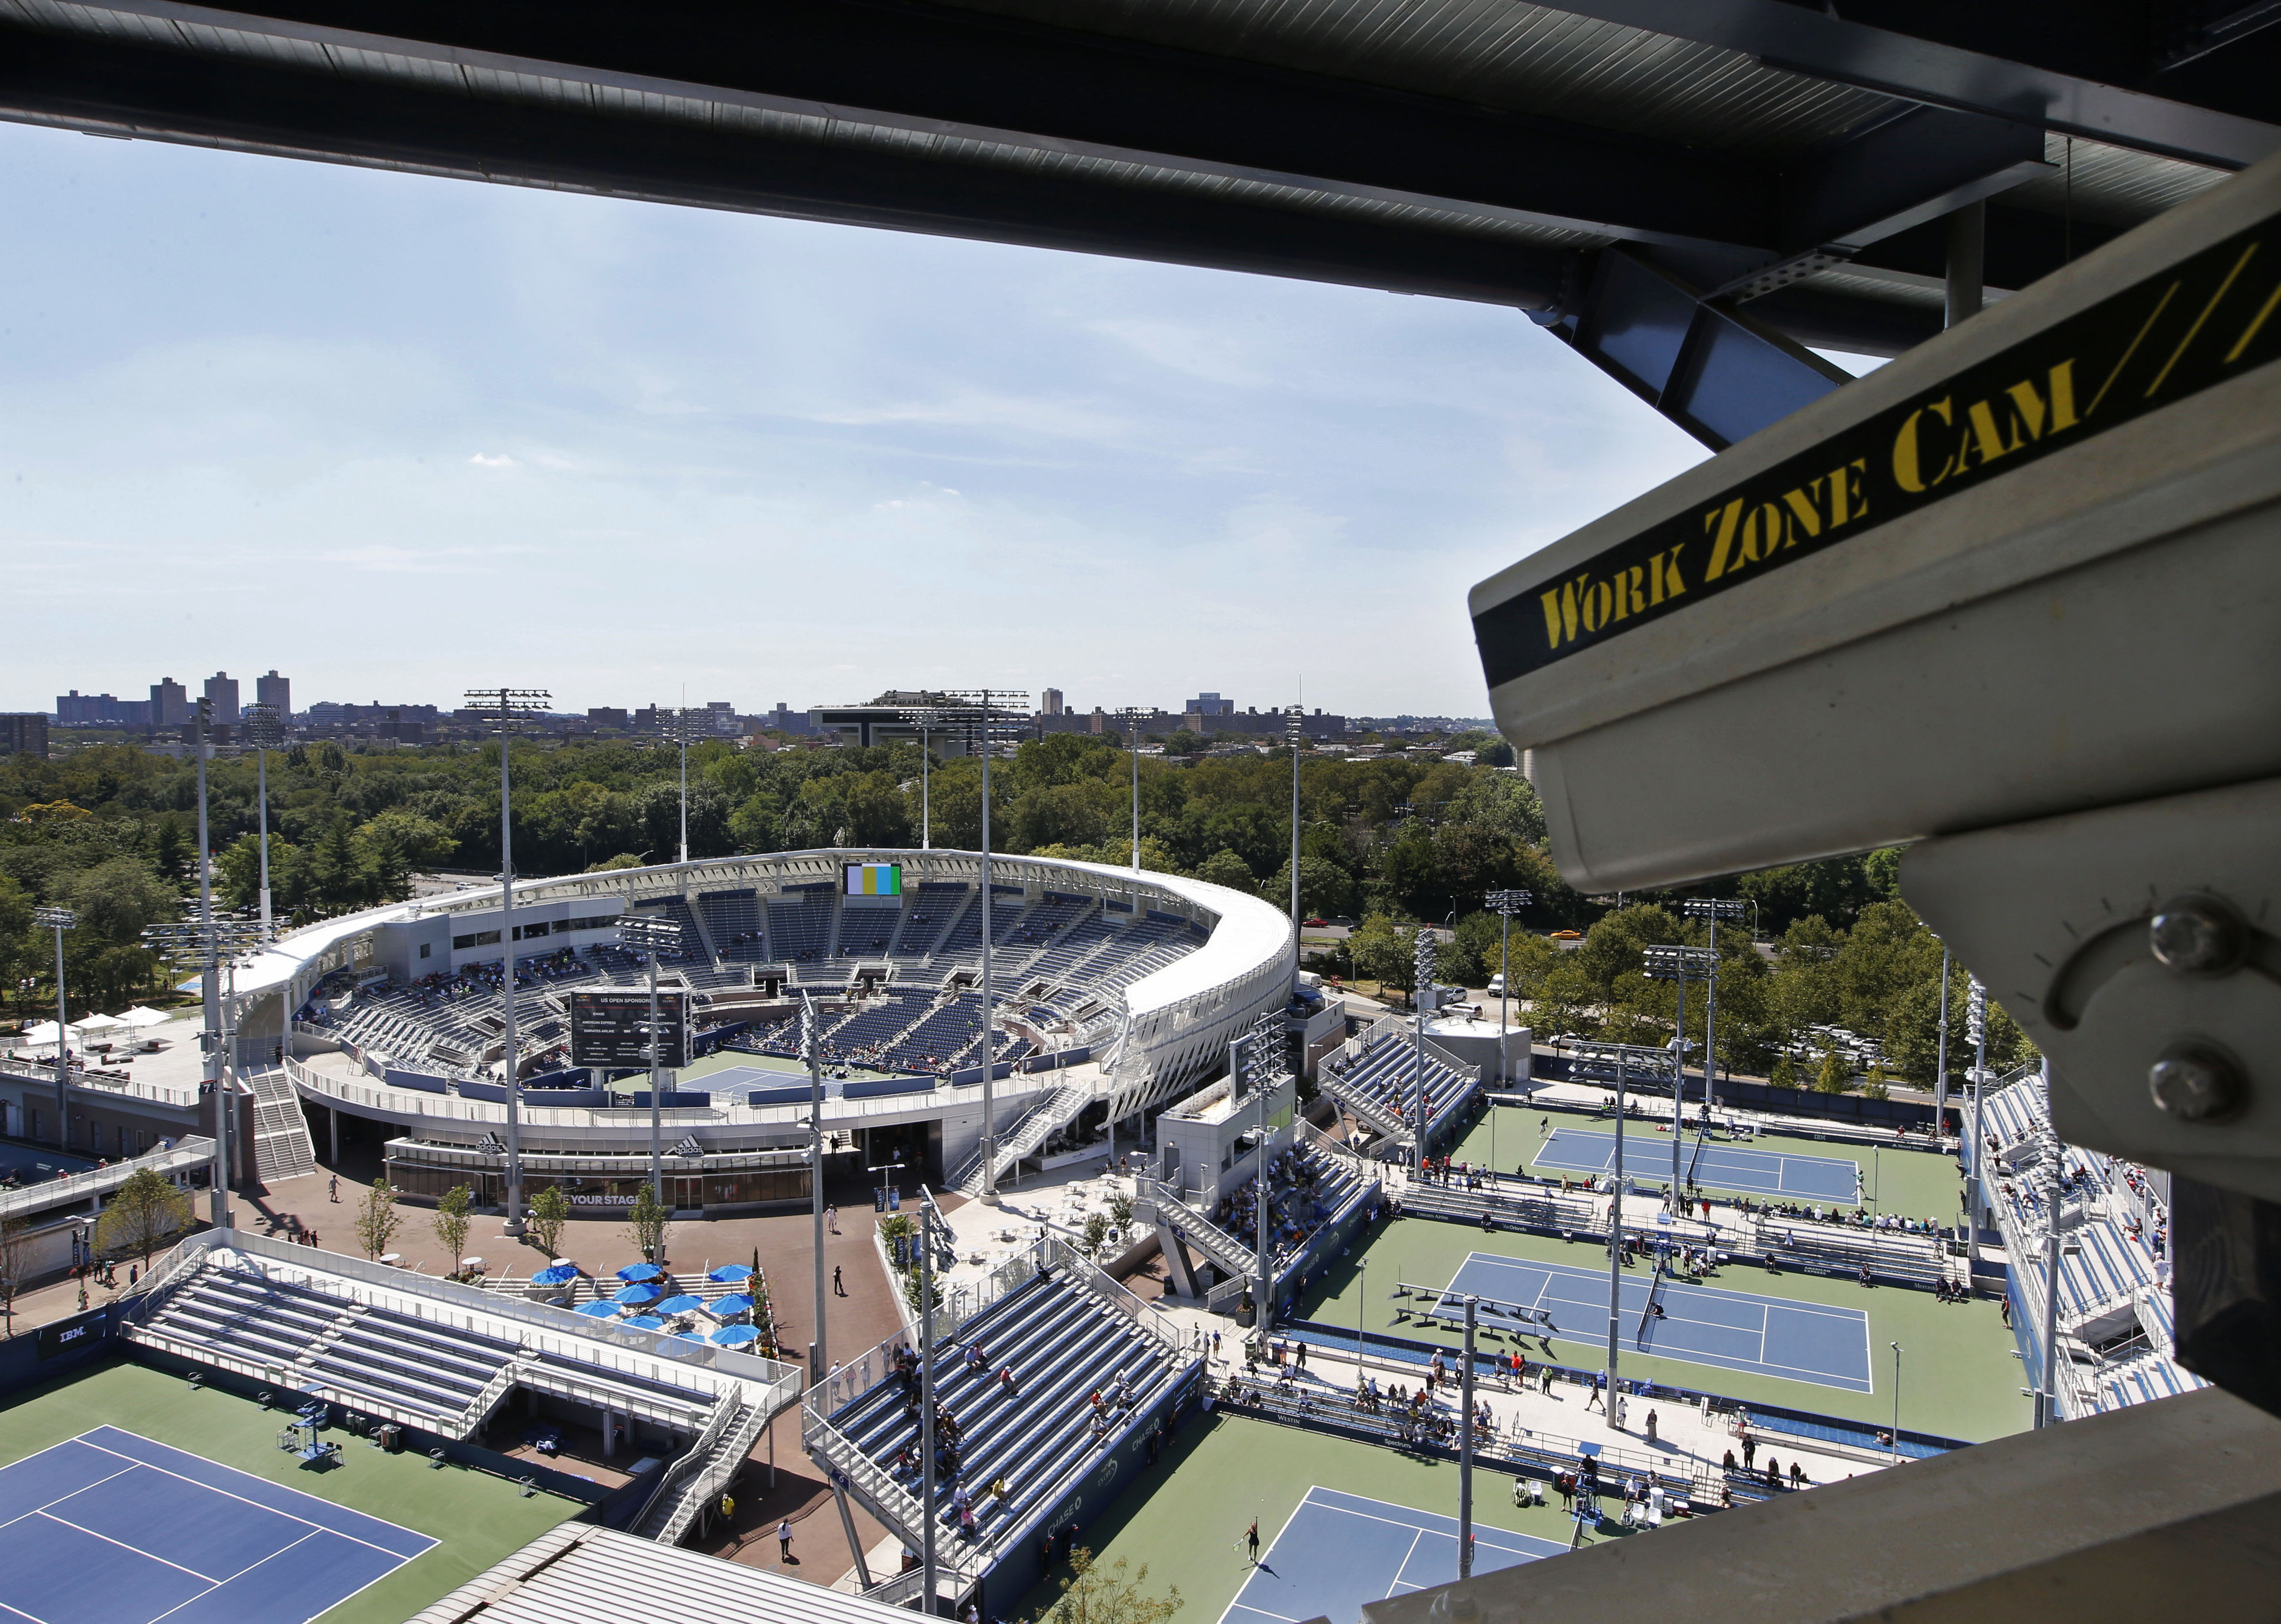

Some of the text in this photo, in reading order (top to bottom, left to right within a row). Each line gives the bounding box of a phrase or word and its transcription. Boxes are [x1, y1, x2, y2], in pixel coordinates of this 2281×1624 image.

[204, 1083, 211, 1093] 7
[571, 1195, 602, 1205] YOUR
[1303, 1258, 1316, 1275] CHASE
[60, 1326, 84, 1342] IBM
[1132, 1424, 1153, 1451] CHASE
[1385, 1438, 1410, 1448] Spectrum
[1048, 1503, 1074, 1536] CHASE
